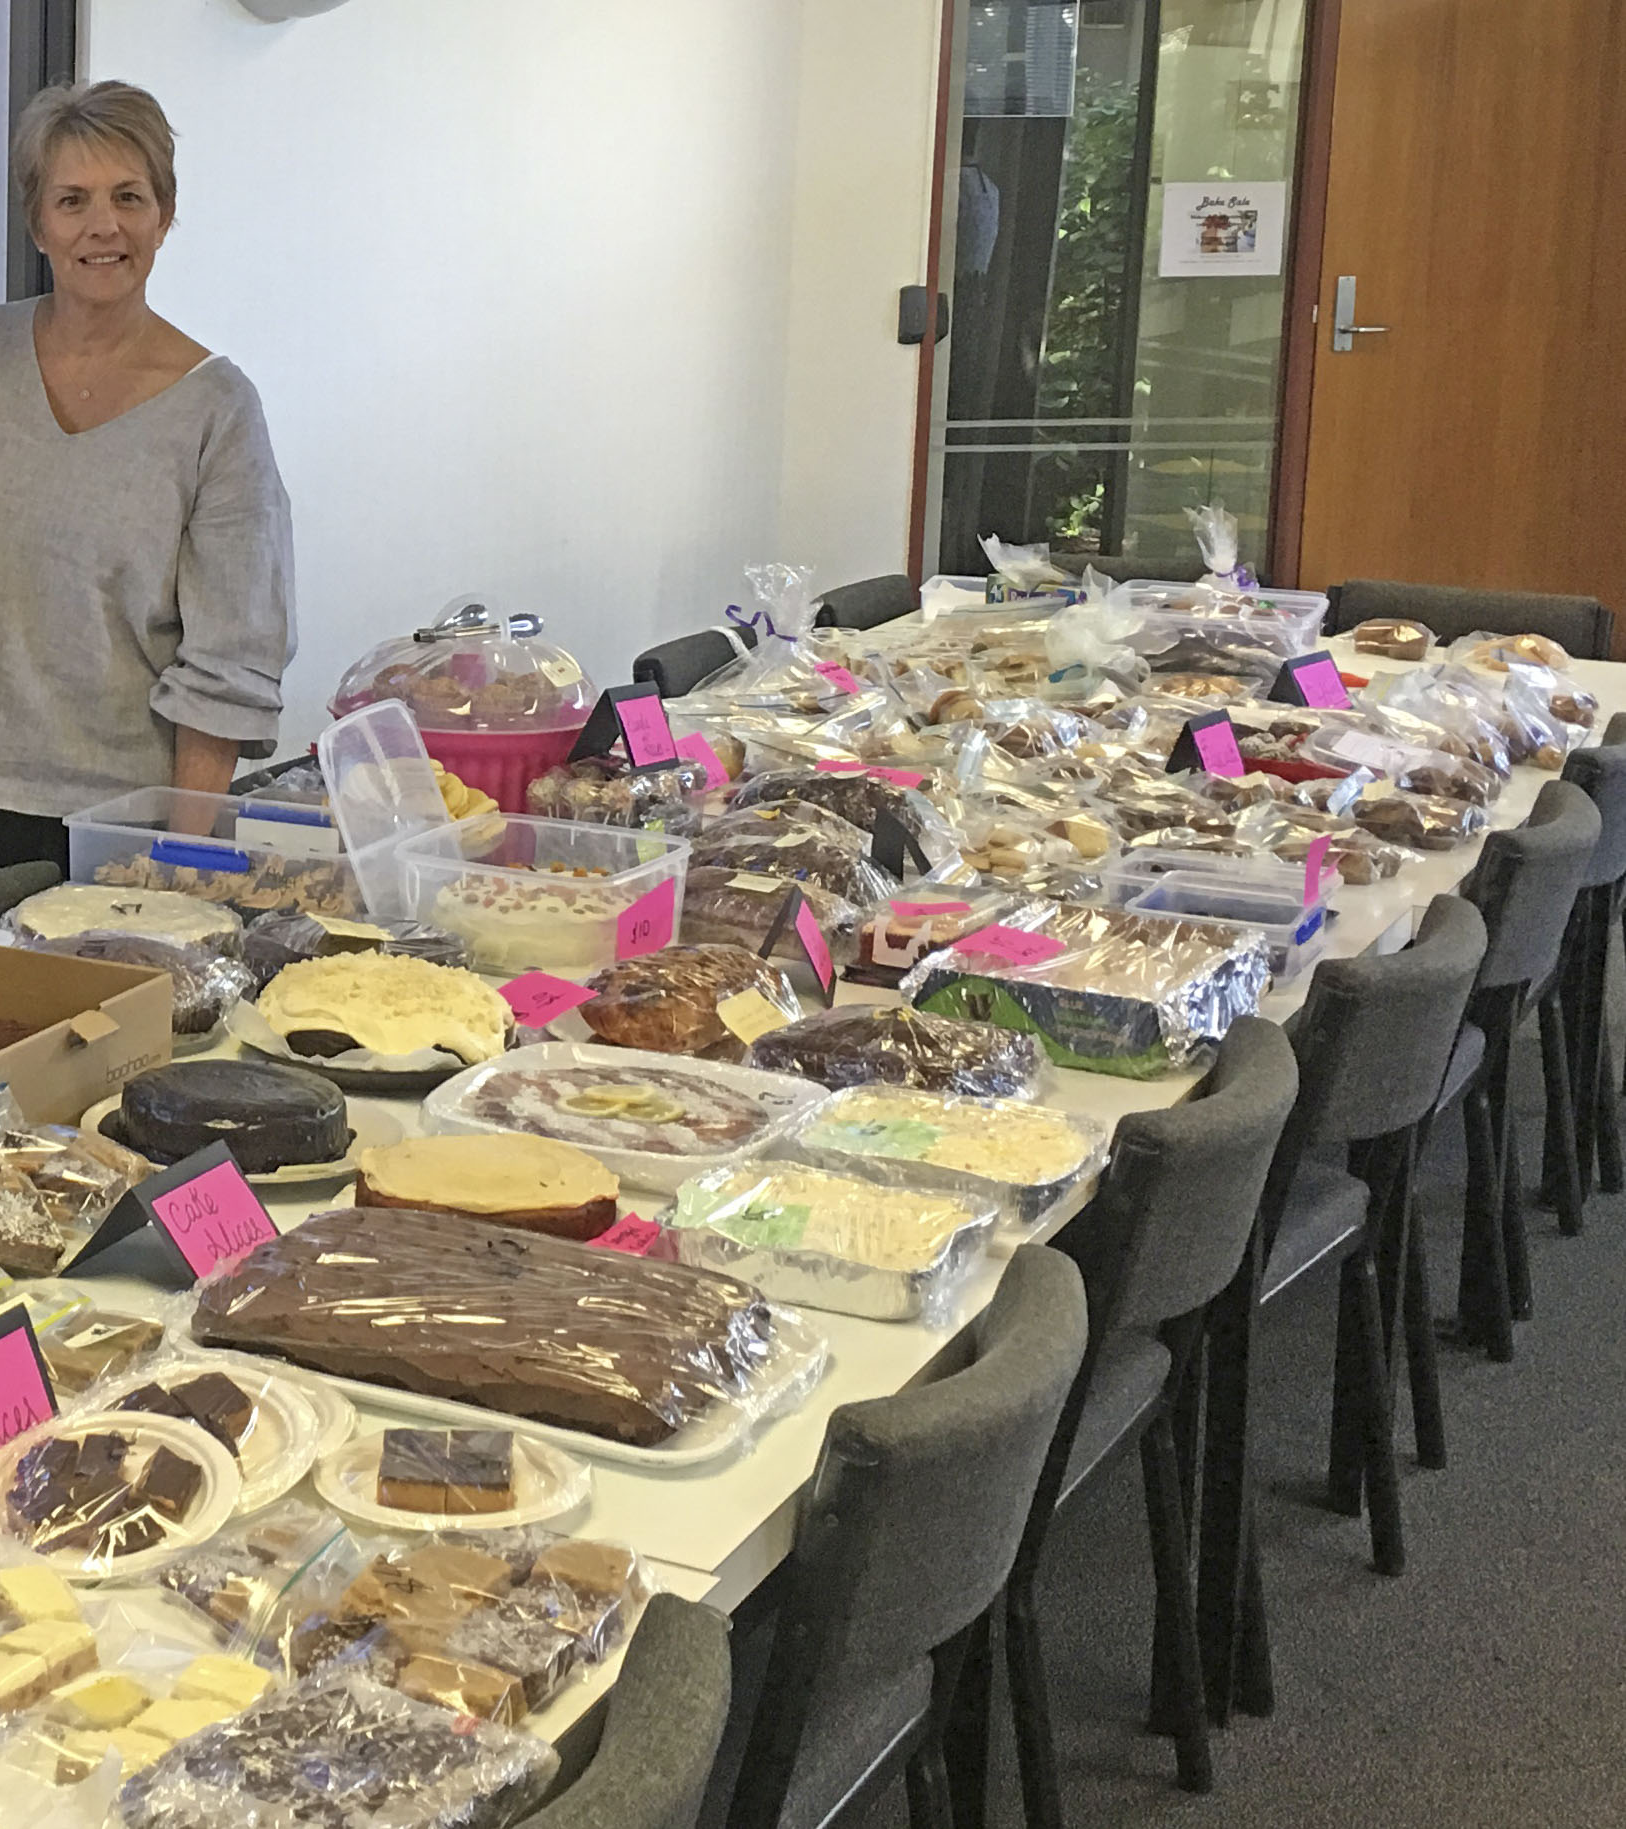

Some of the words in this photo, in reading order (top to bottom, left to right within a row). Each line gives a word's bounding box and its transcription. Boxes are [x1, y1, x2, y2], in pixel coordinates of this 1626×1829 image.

[1196, 197, 1225, 211] Bake
[1227, 196, 1250, 209] Sale
[168, 1186, 219, 1234] Cake
[204, 1216, 272, 1261] Slices
